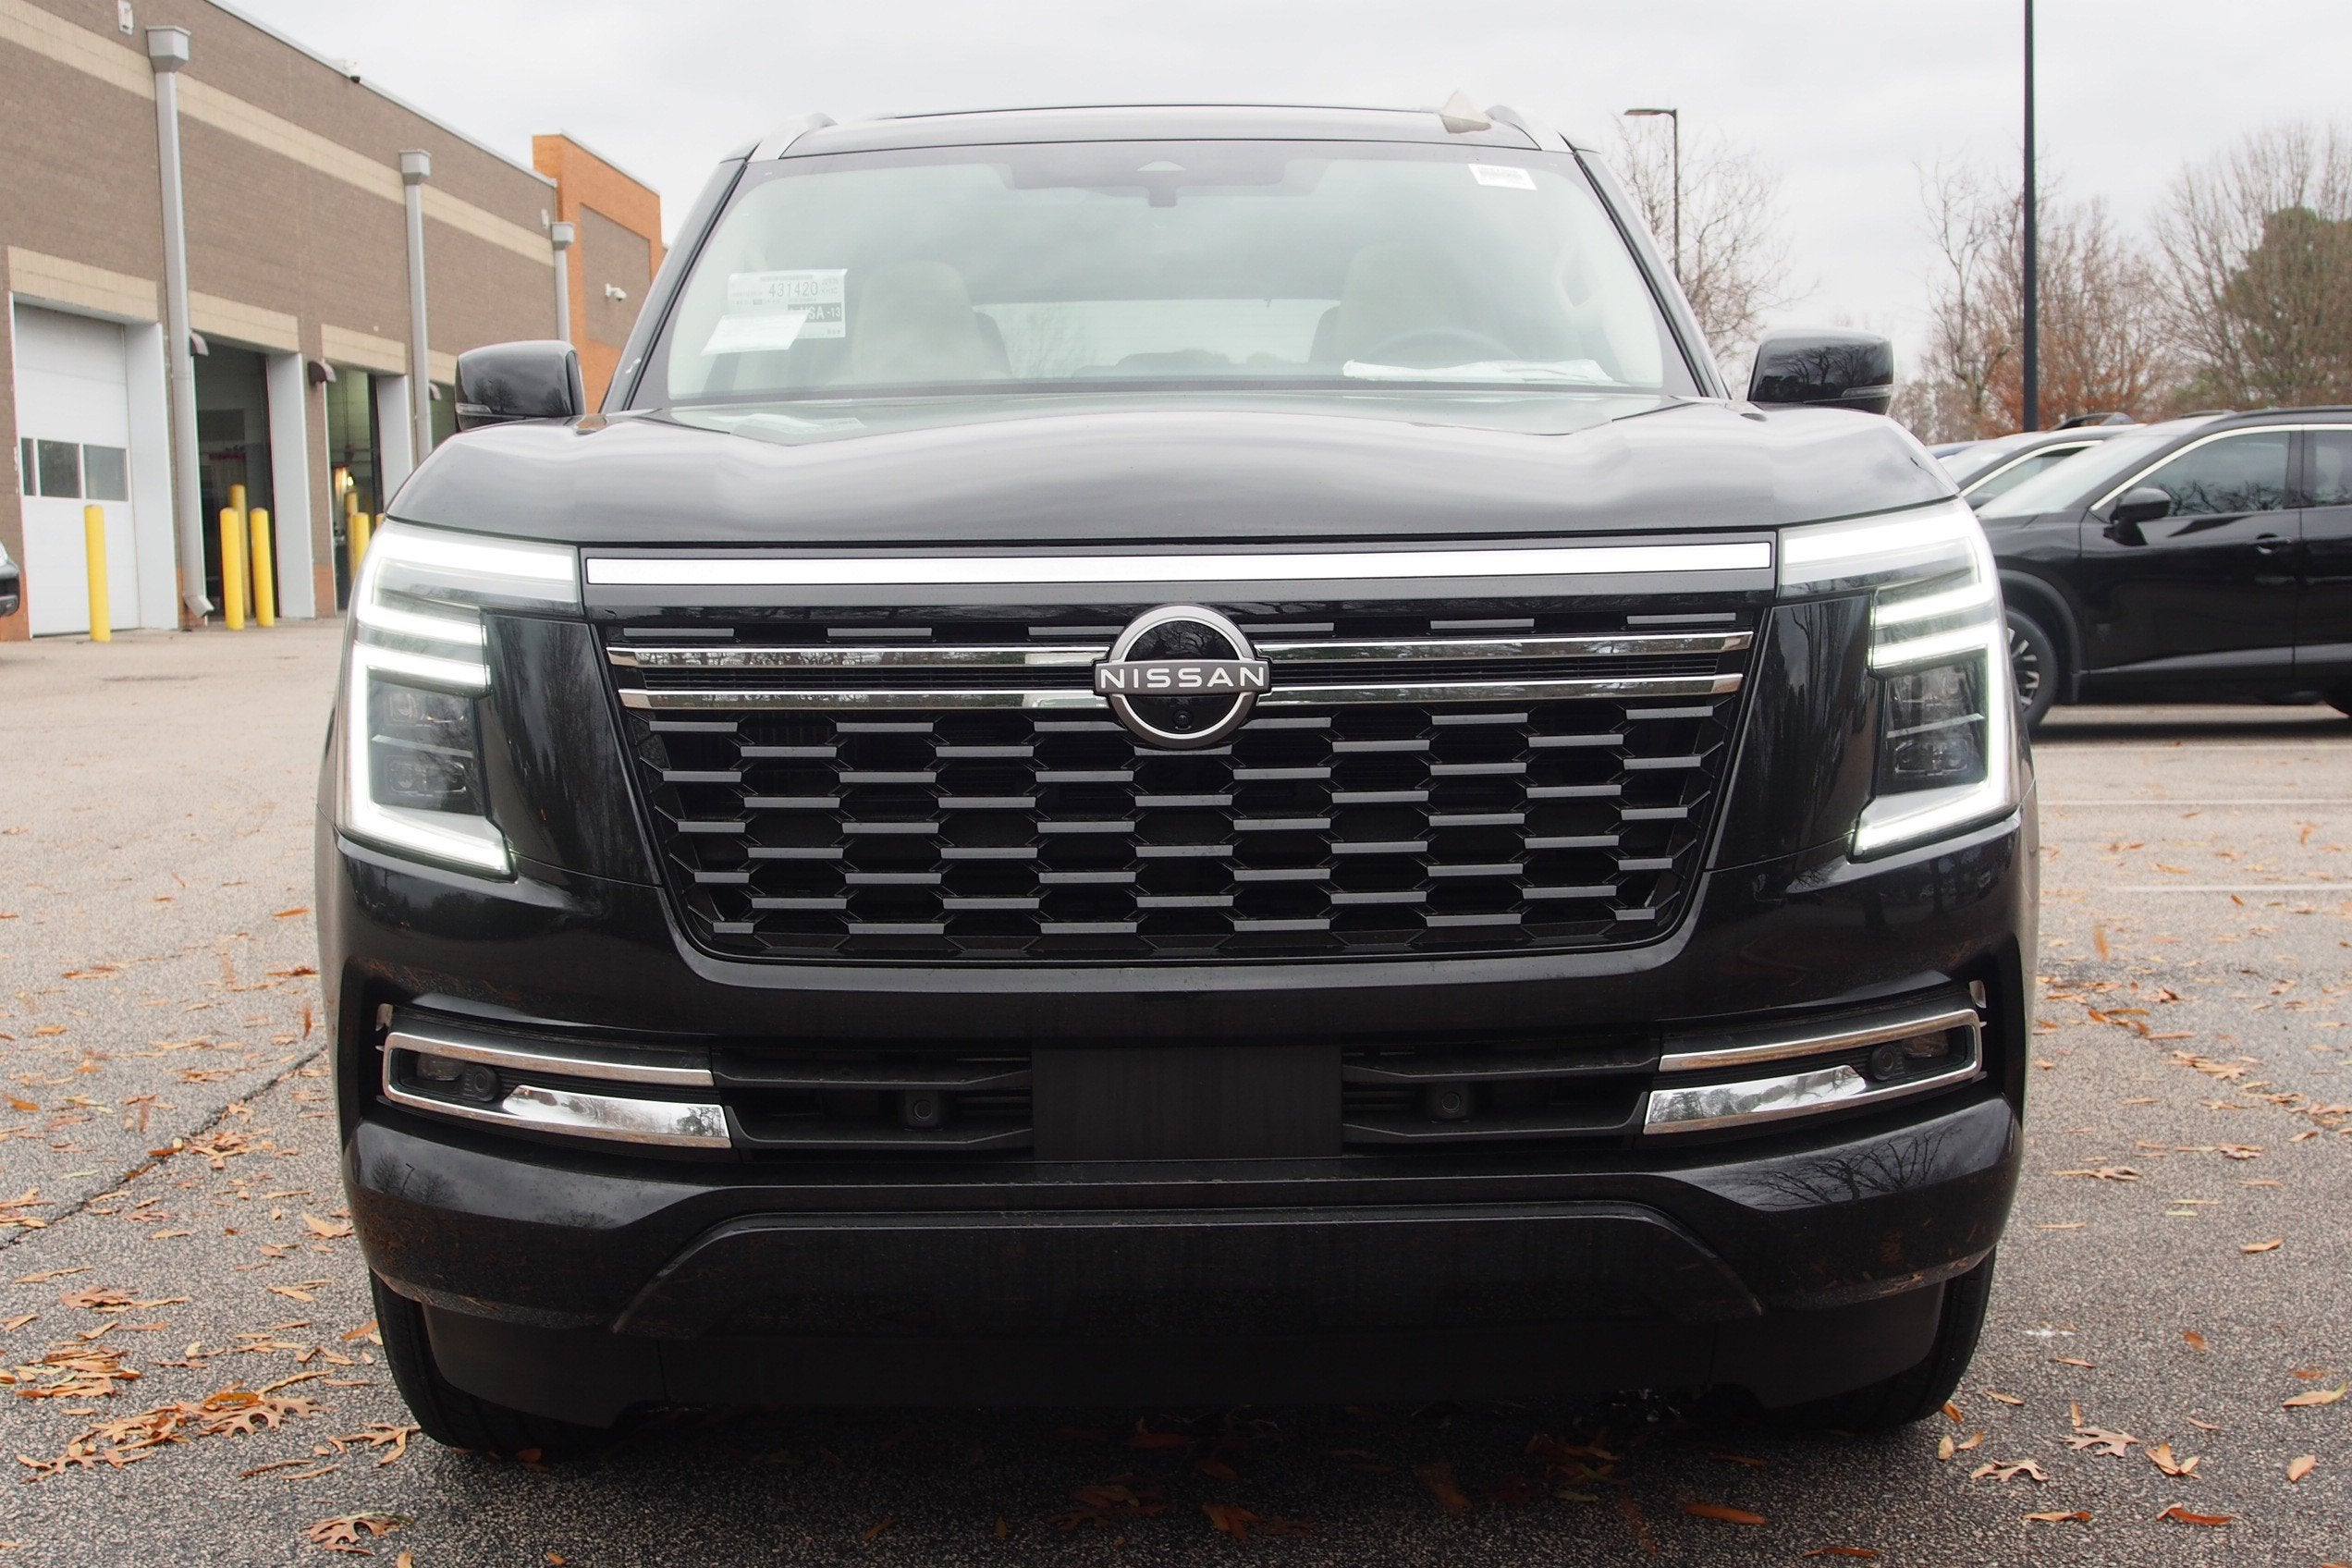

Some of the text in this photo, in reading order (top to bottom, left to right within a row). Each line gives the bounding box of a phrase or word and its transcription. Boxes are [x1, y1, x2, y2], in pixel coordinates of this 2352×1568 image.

[768, 281, 819, 297] 431420
[800, 306, 826, 320] SA
[1100, 667, 1265, 689] NISSAN
